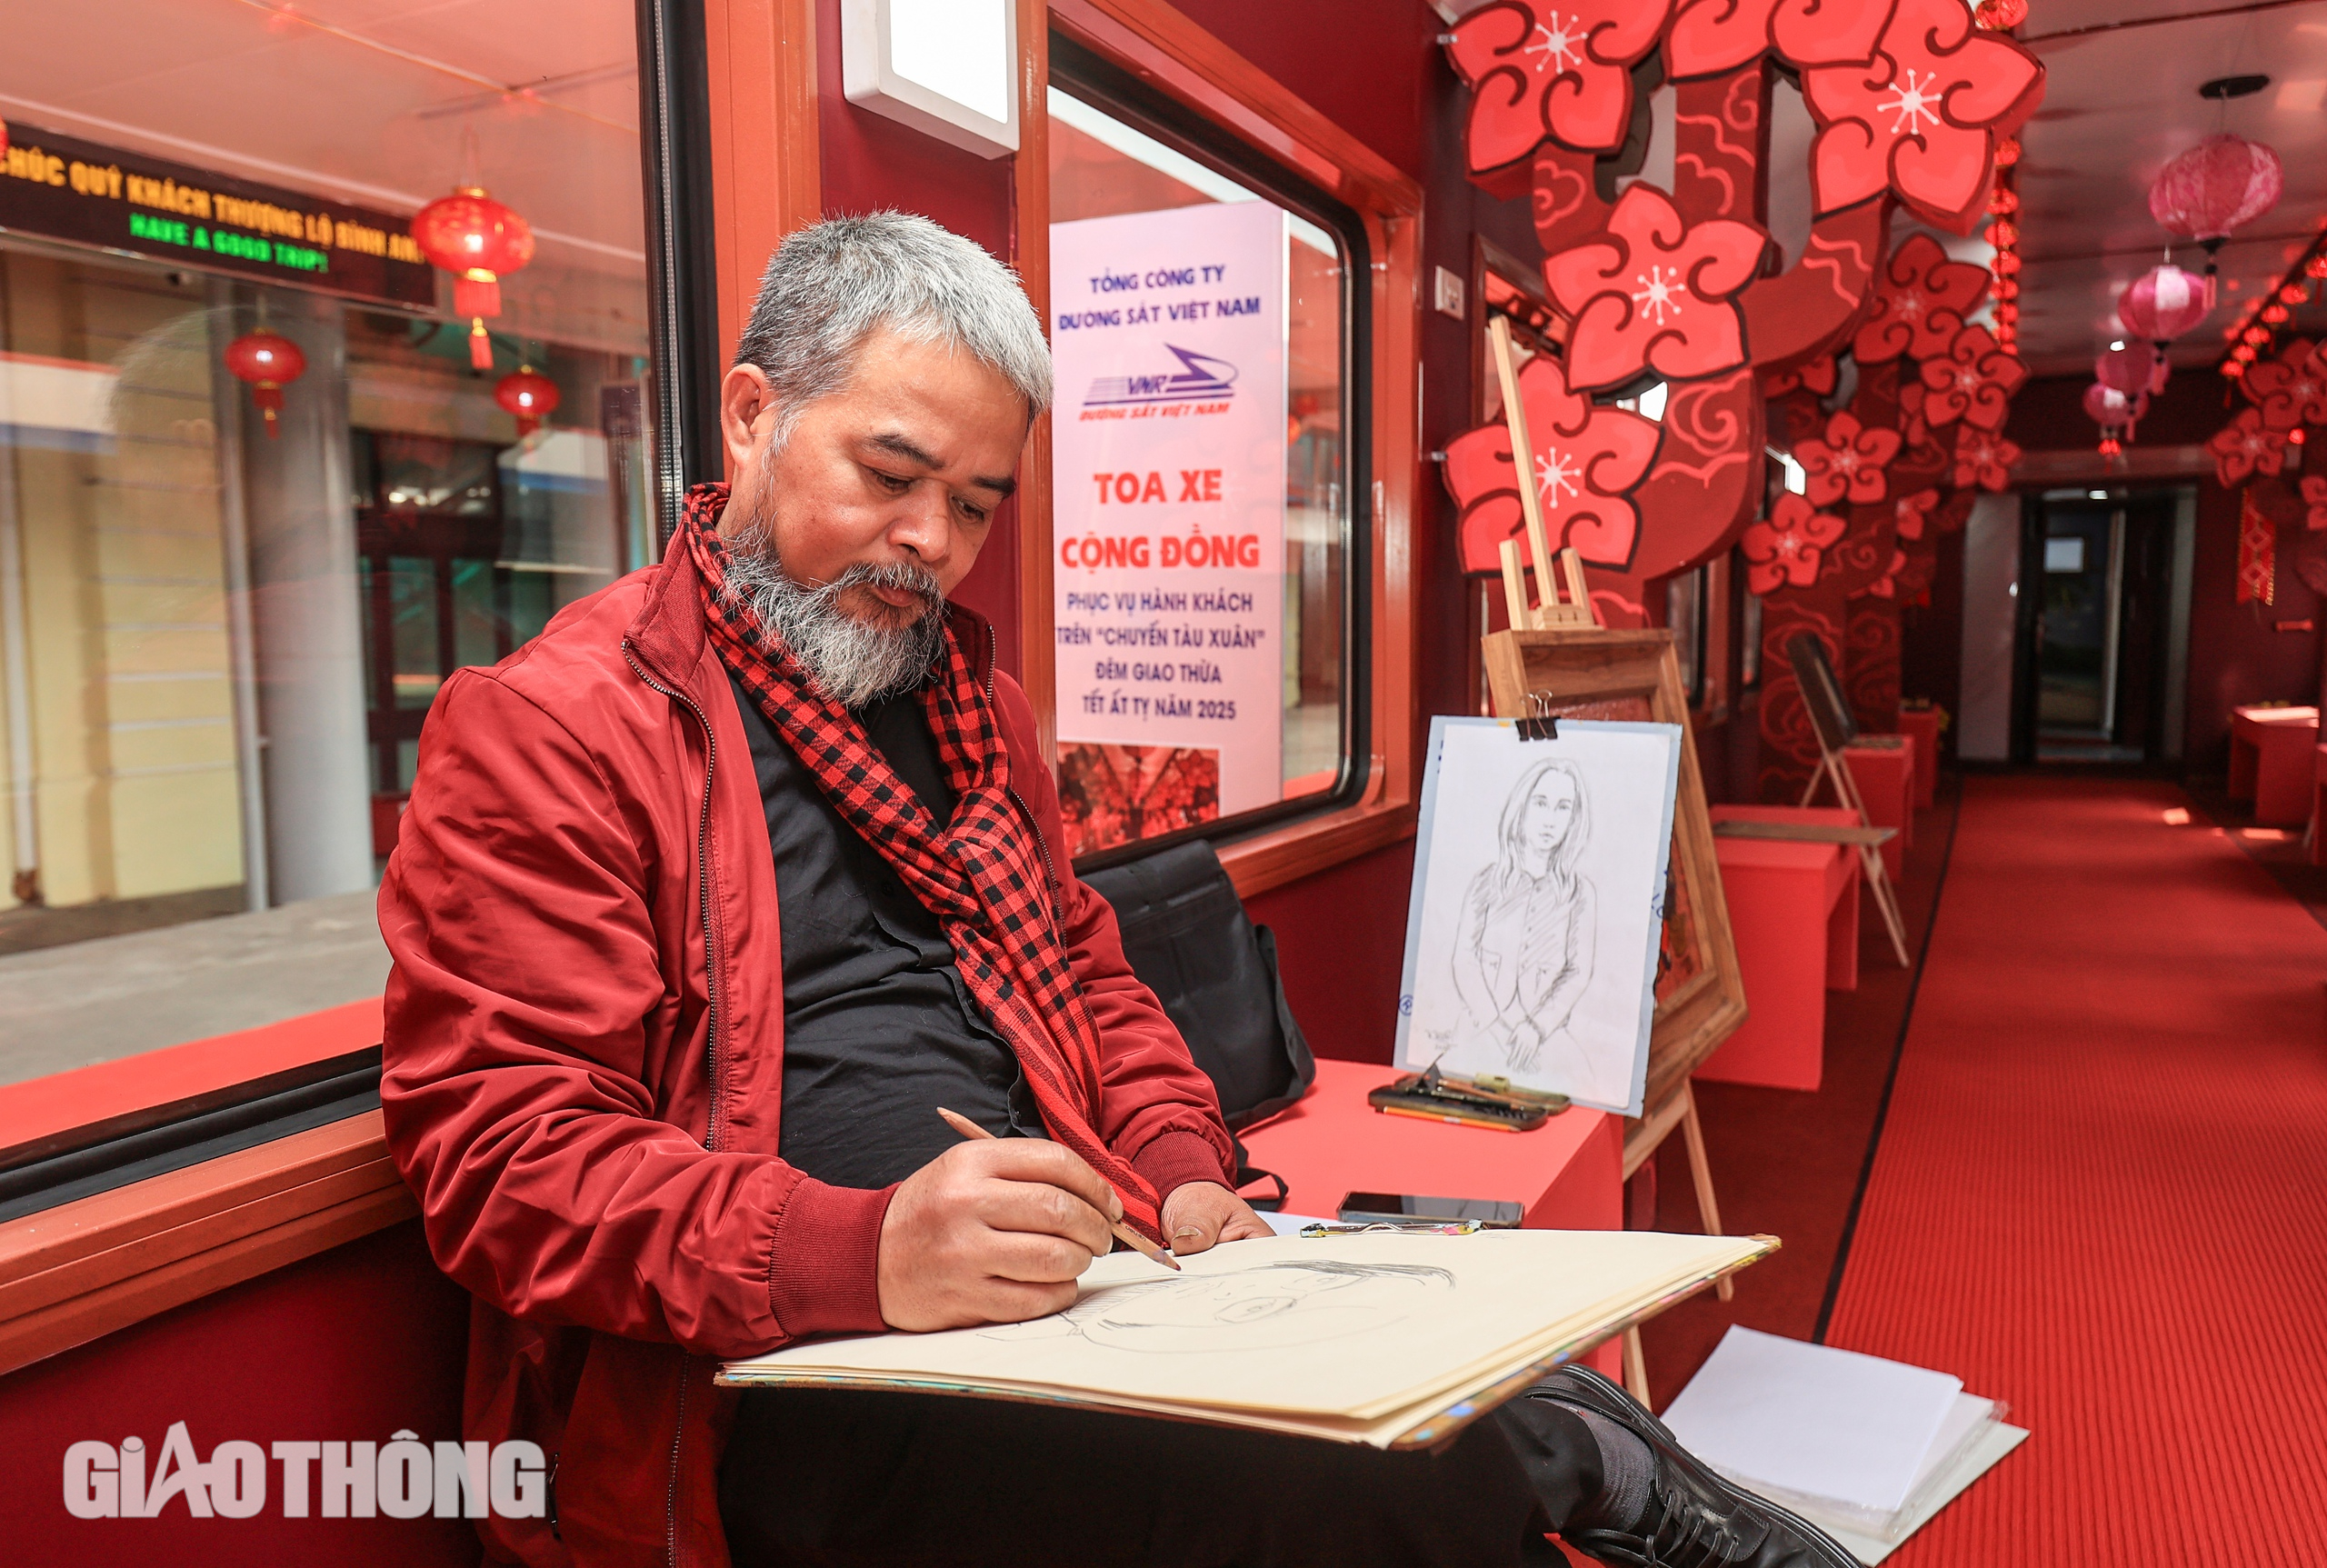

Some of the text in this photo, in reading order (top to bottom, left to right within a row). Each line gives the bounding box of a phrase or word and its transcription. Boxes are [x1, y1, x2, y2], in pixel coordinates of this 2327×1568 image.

[126, 174, 212, 219] KHÁCH
[305, 211, 334, 250] LỘ
[335, 218, 385, 256] BÌNH
[129, 213, 328, 273] HAVE A GOOD TRIP!
[1090, 265, 1225, 294] TỔNG CÔNG TY
[1059, 297, 1260, 330] ĐƯỜNG SẮT VIỆT NAM
[1128, 375, 1167, 394] VNR
[1161, 402, 1191, 418] VIỆT
[1193, 402, 1230, 415] NAM
[1094, 469, 1223, 504] TOA XE
[1061, 524, 1260, 574] CỘNG ĐỒNG
[1066, 587, 1253, 615] PHỤC VỤ HÀNH KHÁCH
[1056, 623, 1091, 644] TRÊN
[1173, 624, 1203, 647] TÀU
[1095, 658, 1222, 683] ĐÊM GIAO THỪA
[1083, 688, 1236, 721] TẾT ẤT TỴ NĂM 2025
